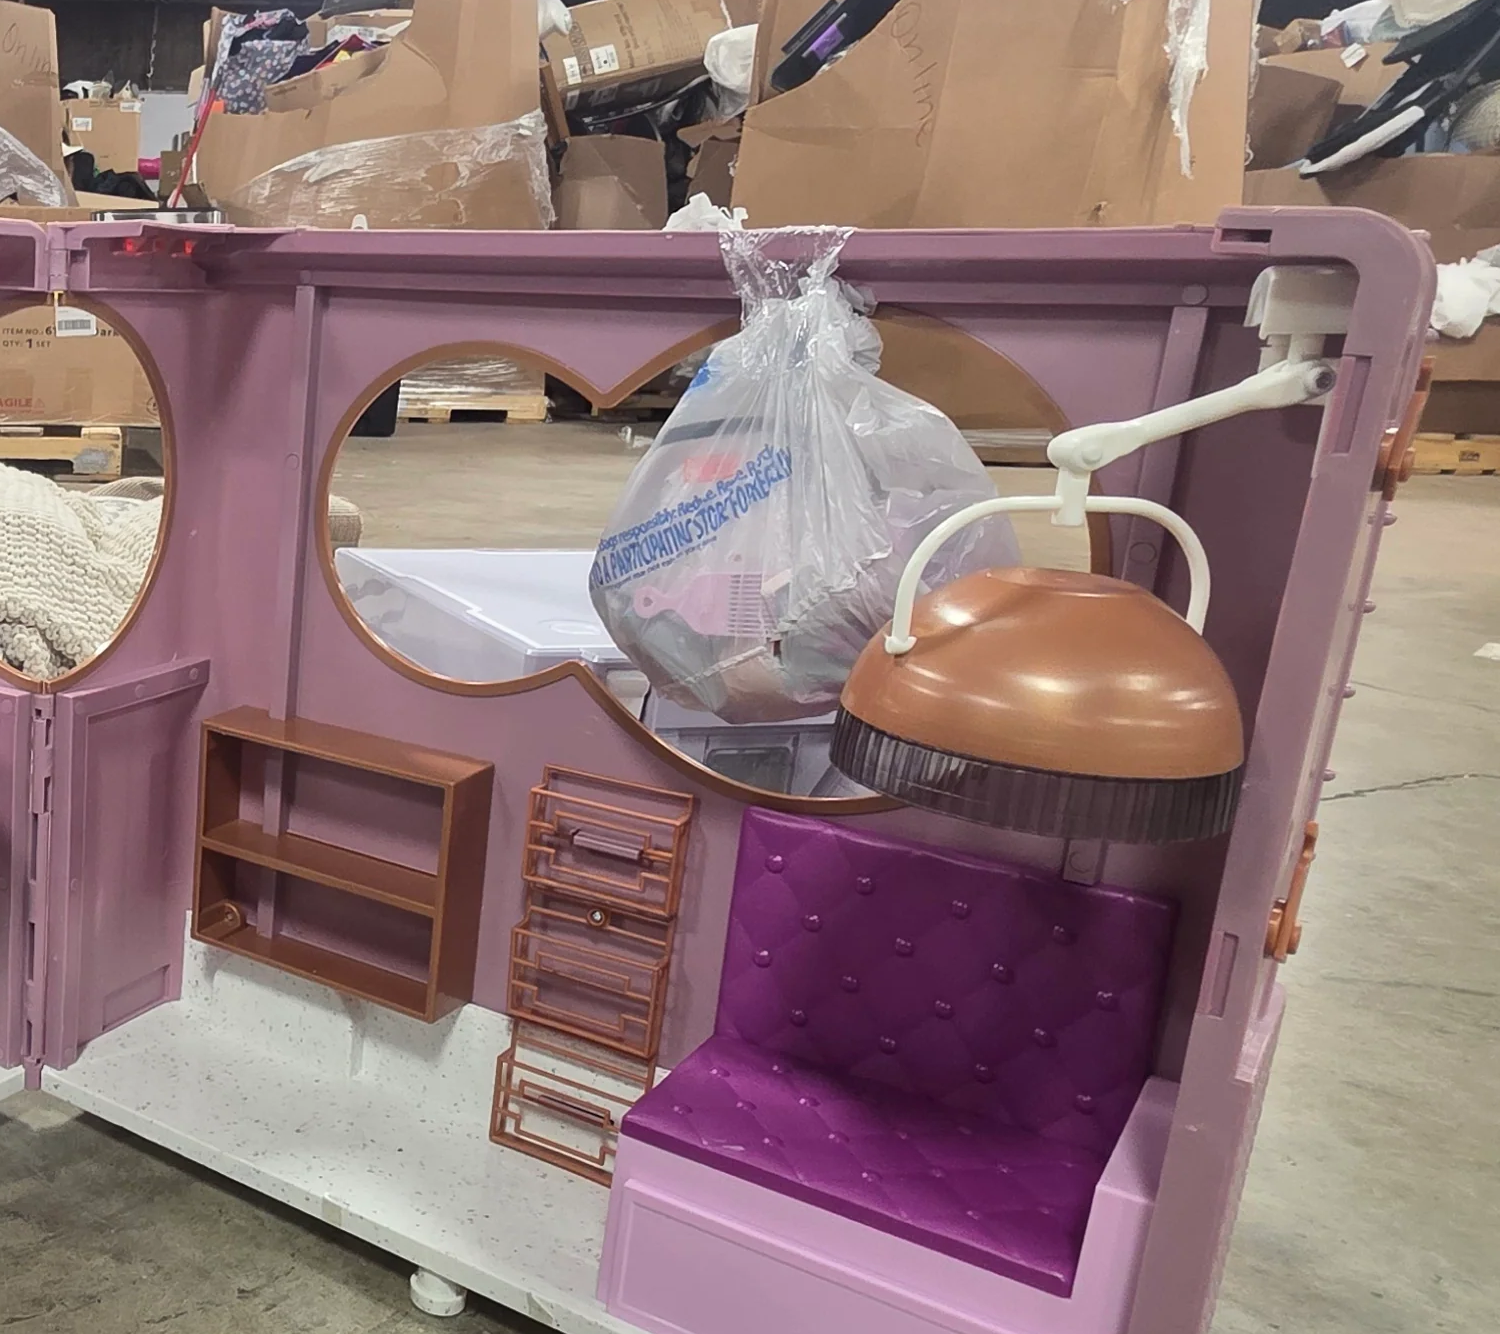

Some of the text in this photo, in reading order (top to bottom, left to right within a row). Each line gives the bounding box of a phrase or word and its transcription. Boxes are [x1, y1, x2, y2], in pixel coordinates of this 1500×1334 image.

[2, 327, 23, 335] ITEM
[26, 338, 33, 349] 1
[36, 340, 51, 348] SET
